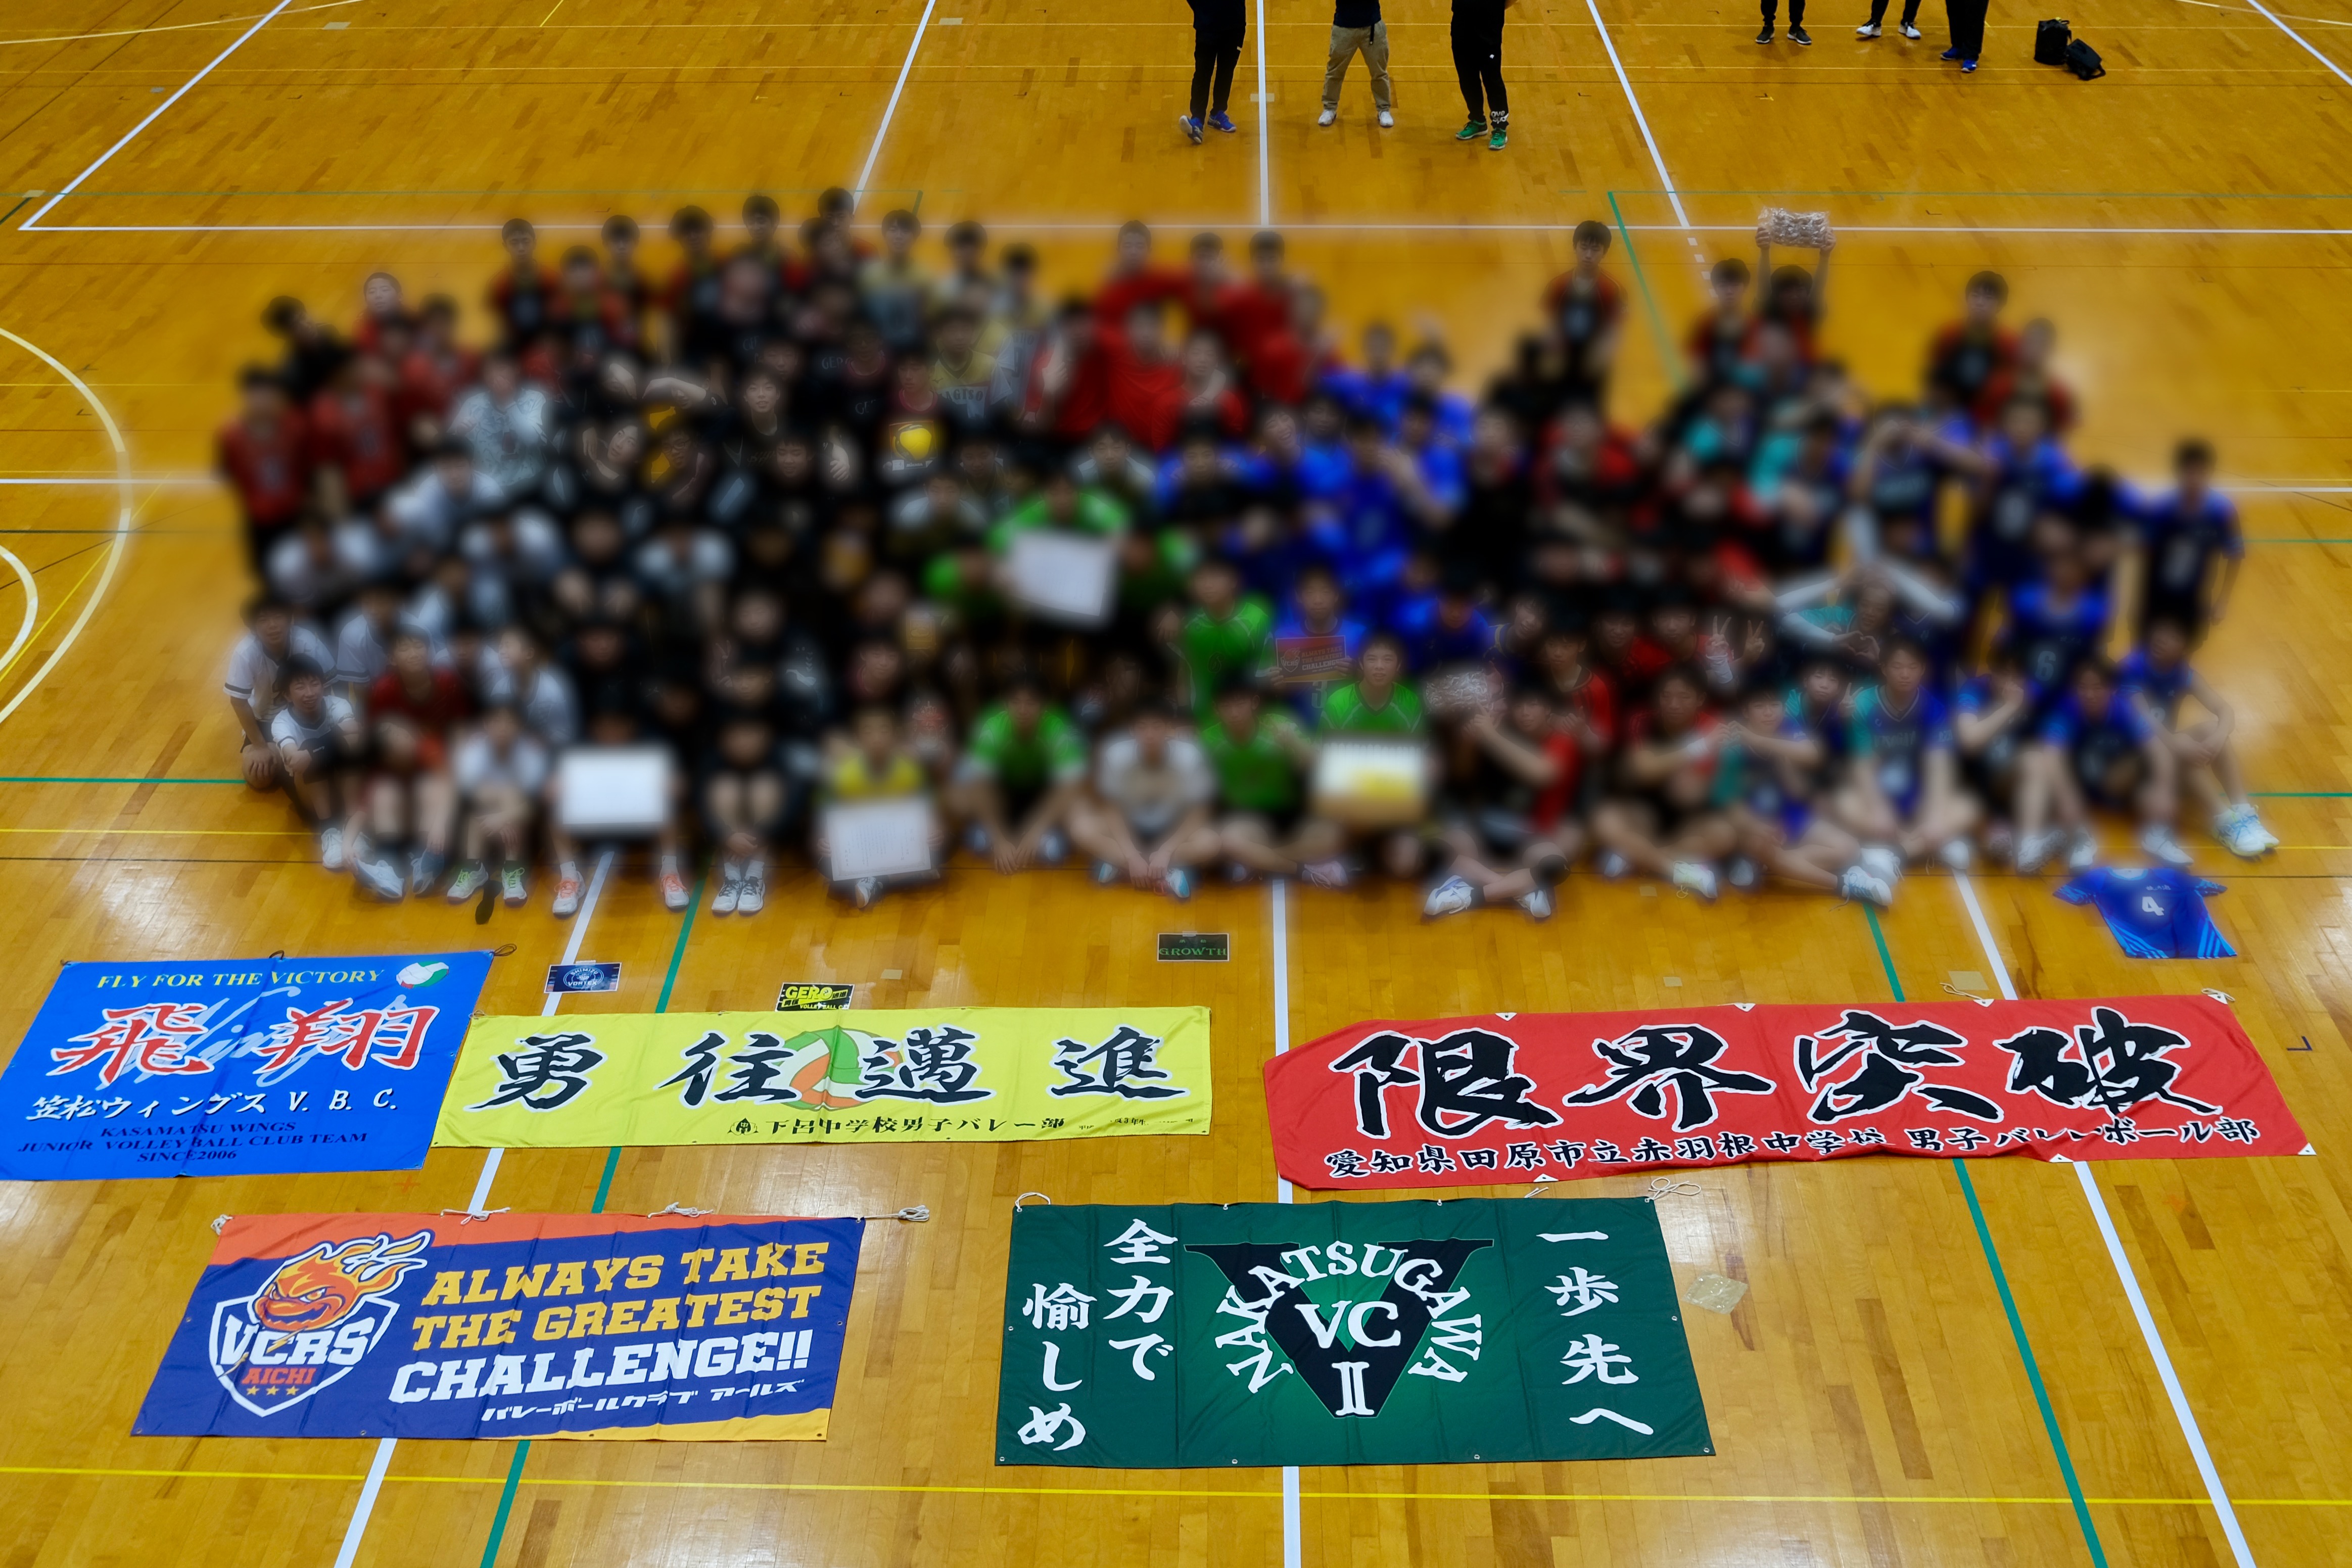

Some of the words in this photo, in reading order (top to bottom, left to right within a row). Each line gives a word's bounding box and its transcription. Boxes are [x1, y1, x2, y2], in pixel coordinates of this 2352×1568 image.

[2142, 896, 2165, 916] 4
[1159, 947, 1227, 956] GROWTH
[97, 975, 142, 988] FLY
[152, 973, 206, 987] FOR
[213, 972, 262, 986] THE
[271, 969, 385, 985] VICTORY
[785, 986, 833, 1000] GERO
[45, 997, 441, 1086] 飛翔
[463, 1022, 1191, 1112] 勇往邁進
[1328, 1006, 2224, 1139] 限界突破
[26, 1092, 266, 1121] 笠松ウィングス
[289, 1091, 308, 1111] V.
[329, 1089, 352, 1111] B.
[372, 1088, 397, 1110] C.
[101, 1124, 223, 1138] KASAMATSU
[230, 1122, 297, 1133] WINGS
[18, 1141, 93, 1153] JUNIOR
[249, 1135, 303, 1146] CLUB
[310, 1133, 367, 1144] TEAM
[420, 1254, 662, 1307] ALWAYS
[683, 1242, 830, 1284] TAKE
[1103, 1218, 1179, 1381] 全力で
[216, 1314, 376, 1366] VCRS
[412, 1308, 523, 1351] THE
[532, 1285, 822, 1342] GREATEST
[1214, 1240, 1483, 1394] NAKATSUGAWA
[1294, 1299, 1402, 1349] VC
[1536, 1230, 1654, 1436] 一歩先へ
[241, 1367, 318, 1385] AICHI
[388, 1329, 813, 1403] CHALLENGE!!
[1017, 1282, 1098, 1451] 愉しめ
[482, 1389, 699, 1421] バレーボールクラブ
[710, 1378, 806, 1402] アールズ
